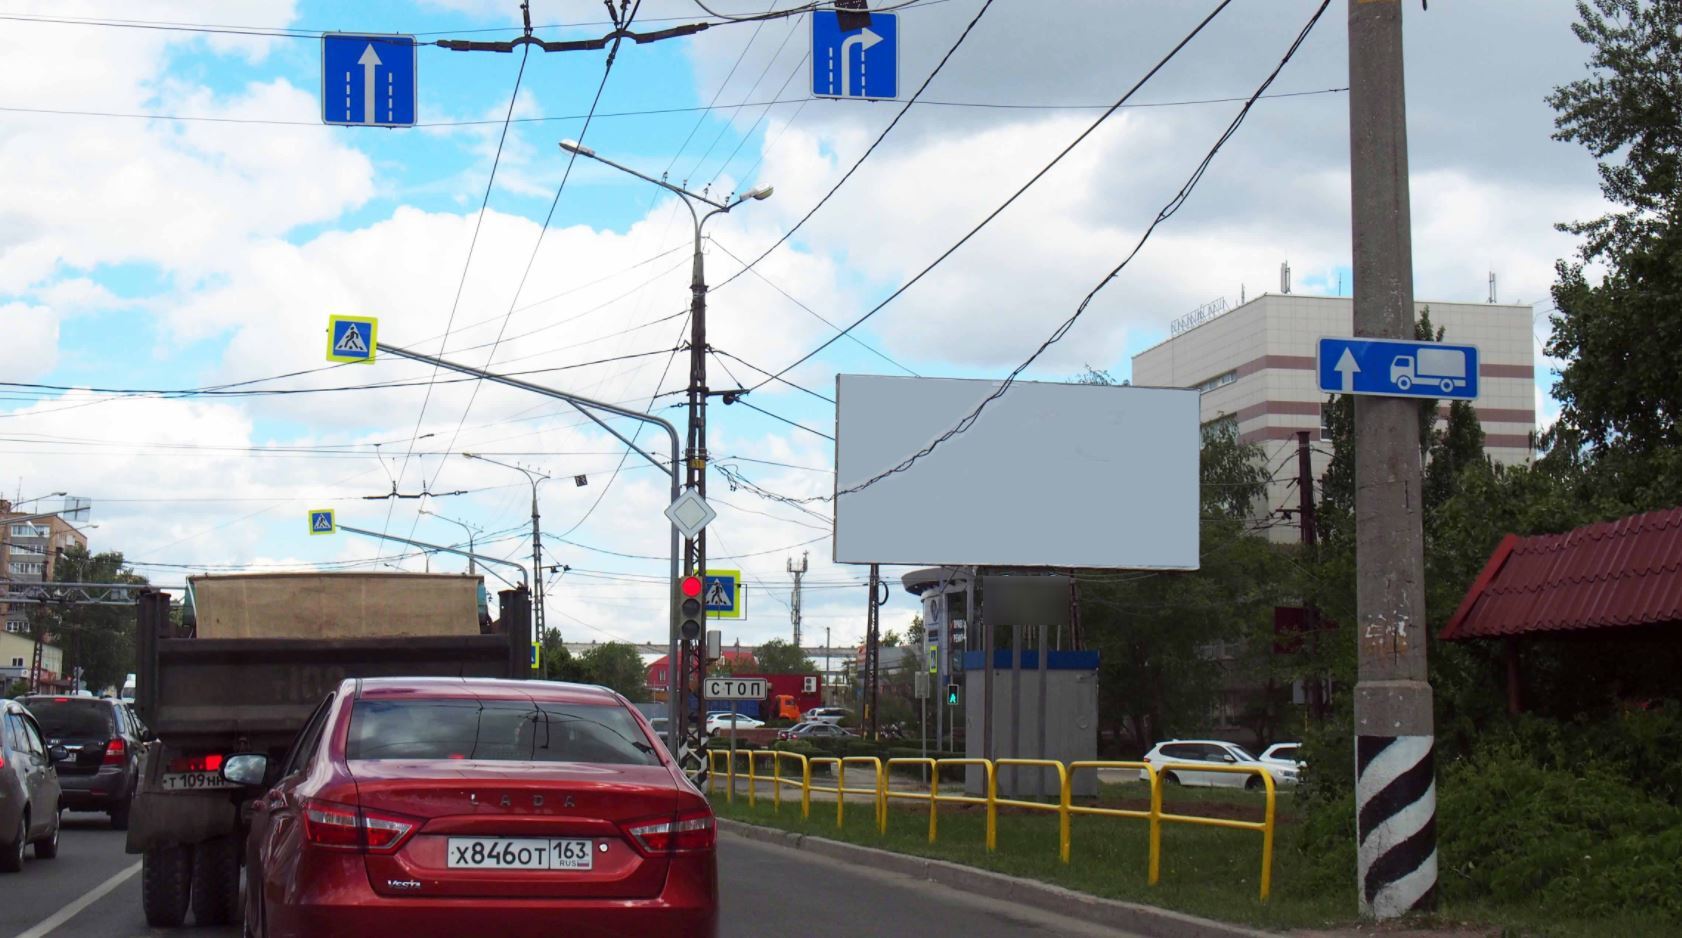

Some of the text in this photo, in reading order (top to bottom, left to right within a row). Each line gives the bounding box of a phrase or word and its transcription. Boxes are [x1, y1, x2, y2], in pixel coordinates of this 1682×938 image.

[711, 682, 760, 696] СТОП
[471, 794, 576, 807] LADA
[553, 842, 586, 859] 163
[560, 859, 577, 867] RUS
